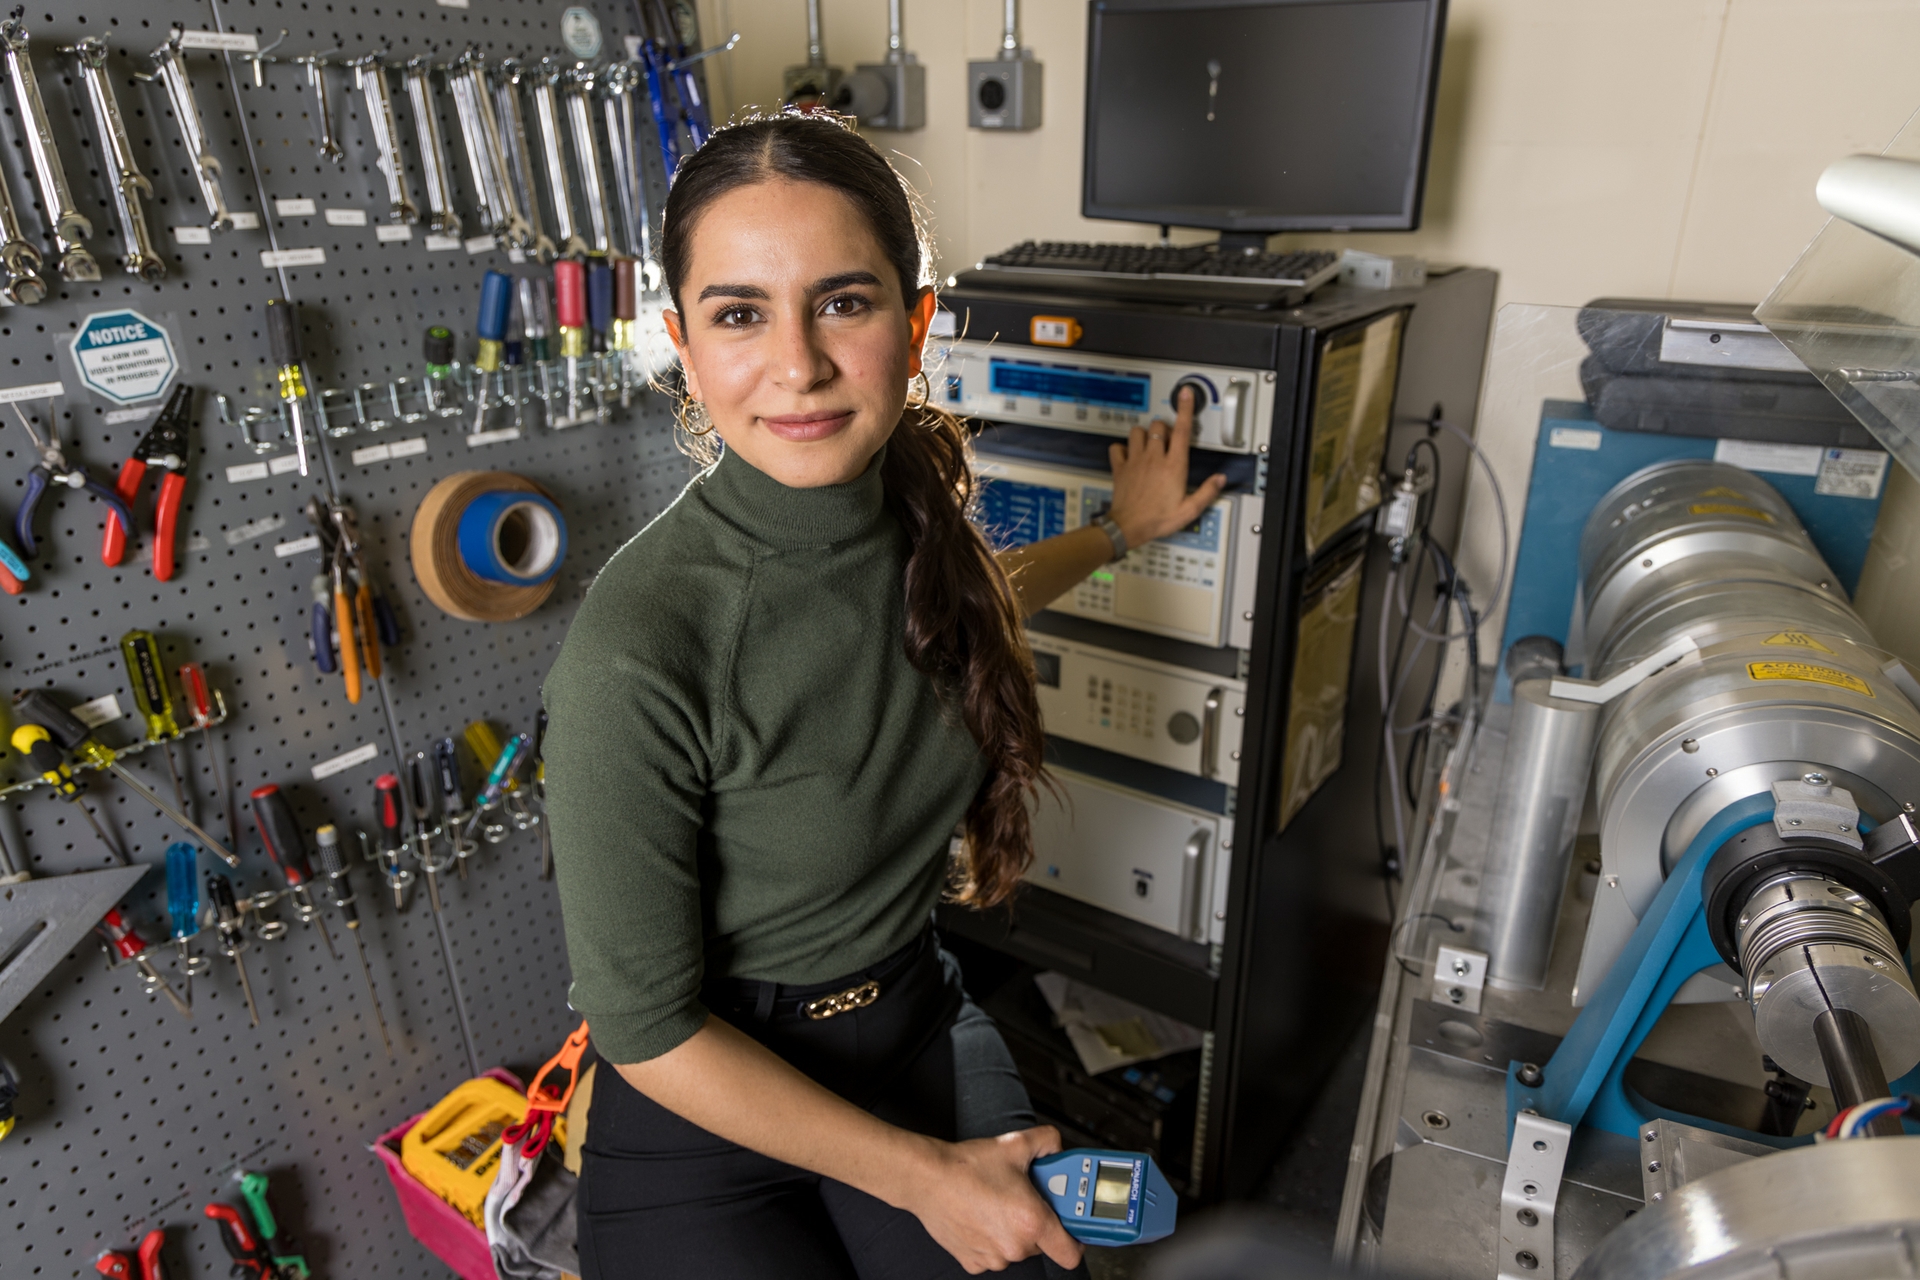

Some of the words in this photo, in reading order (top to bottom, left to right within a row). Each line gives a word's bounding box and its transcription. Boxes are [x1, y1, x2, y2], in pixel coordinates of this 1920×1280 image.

[88, 323, 148, 346] NOTICE
[102, 351, 130, 362] ALARM
[132, 348, 149, 358] AND
[90, 365, 114, 376] VIDEO
[116, 357, 167, 371] MONITORING
[106, 377, 114, 385] IN
[117, 369, 159, 382] PROGRESS
[22, 659, 65, 677] TAPE
[1775, 663, 1843, 677] CAUTION
[1131, 1159, 1142, 1201] MONARCH
